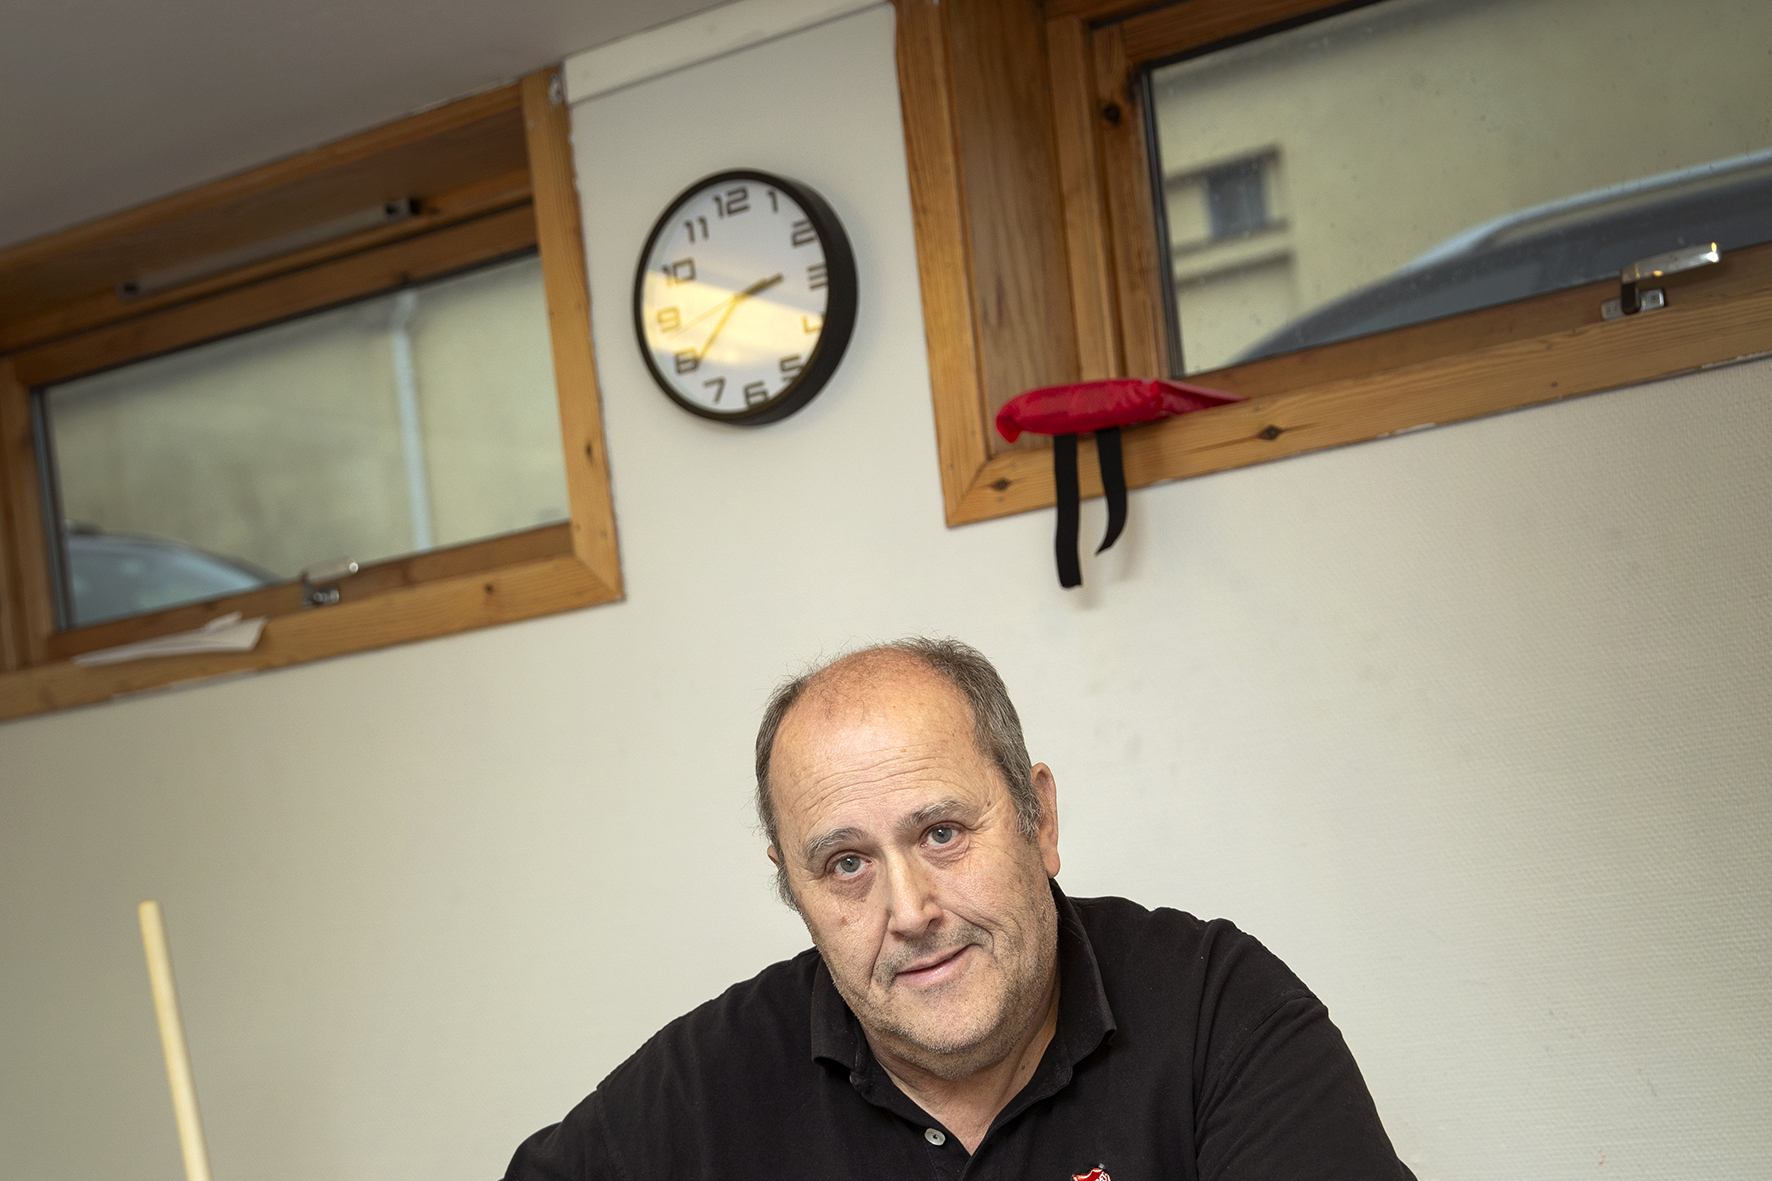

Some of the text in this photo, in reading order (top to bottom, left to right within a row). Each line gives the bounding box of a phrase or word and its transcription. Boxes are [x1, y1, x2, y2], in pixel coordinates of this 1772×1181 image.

[713, 187, 750, 218] 12
[767, 188, 778, 214] 1
[684, 216, 709, 243] 11
[791, 218, 818, 248] 2
[662, 257, 695, 287] 10
[806, 262, 828, 291] 3
[657, 306, 681, 333] 9
[802, 312, 825, 335] 4
[675, 348, 700, 374] 8
[779, 354, 804, 382] 5
[704, 377, 725, 403] 7
[743, 380, 771, 405] 6
